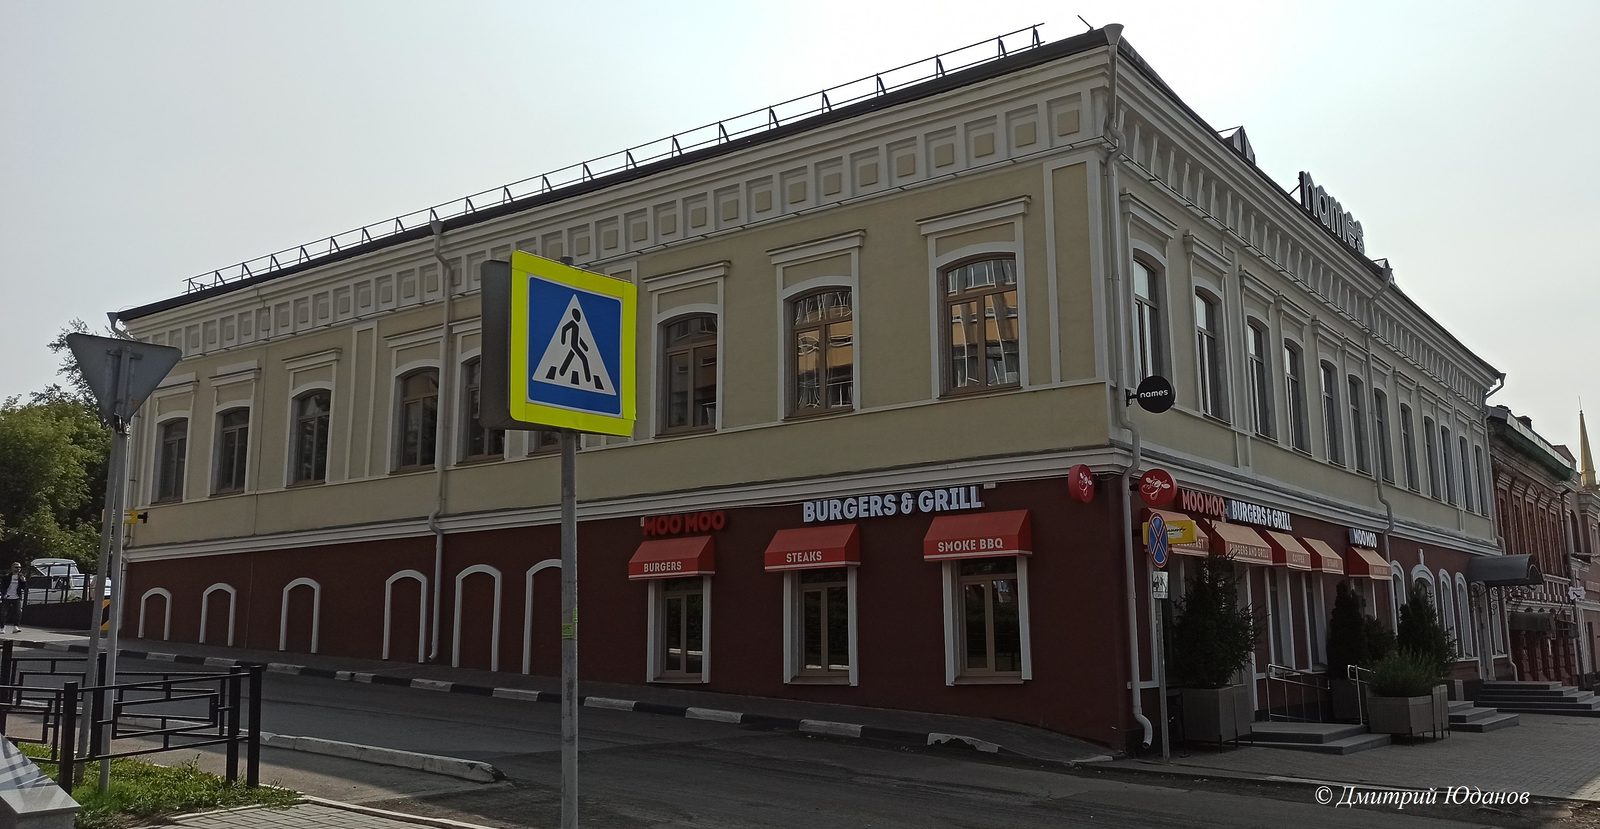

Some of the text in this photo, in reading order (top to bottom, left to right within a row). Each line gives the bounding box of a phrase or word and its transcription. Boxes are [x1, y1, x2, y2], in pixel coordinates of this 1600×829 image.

[1299, 171, 1365, 254] names
[1140, 389, 1169, 399] names
[803, 486, 983, 522] BURGERS & GRILL
[1181, 488, 1226, 518] MOO MOO
[643, 511, 726, 536] MOO MOO
[1231, 500, 1293, 532] BURGERS & GRILL
[785, 551, 823, 563] STEAKS
[937, 538, 1004, 552] SMOKE BBQ
[643, 560, 683, 573] BURGERS
